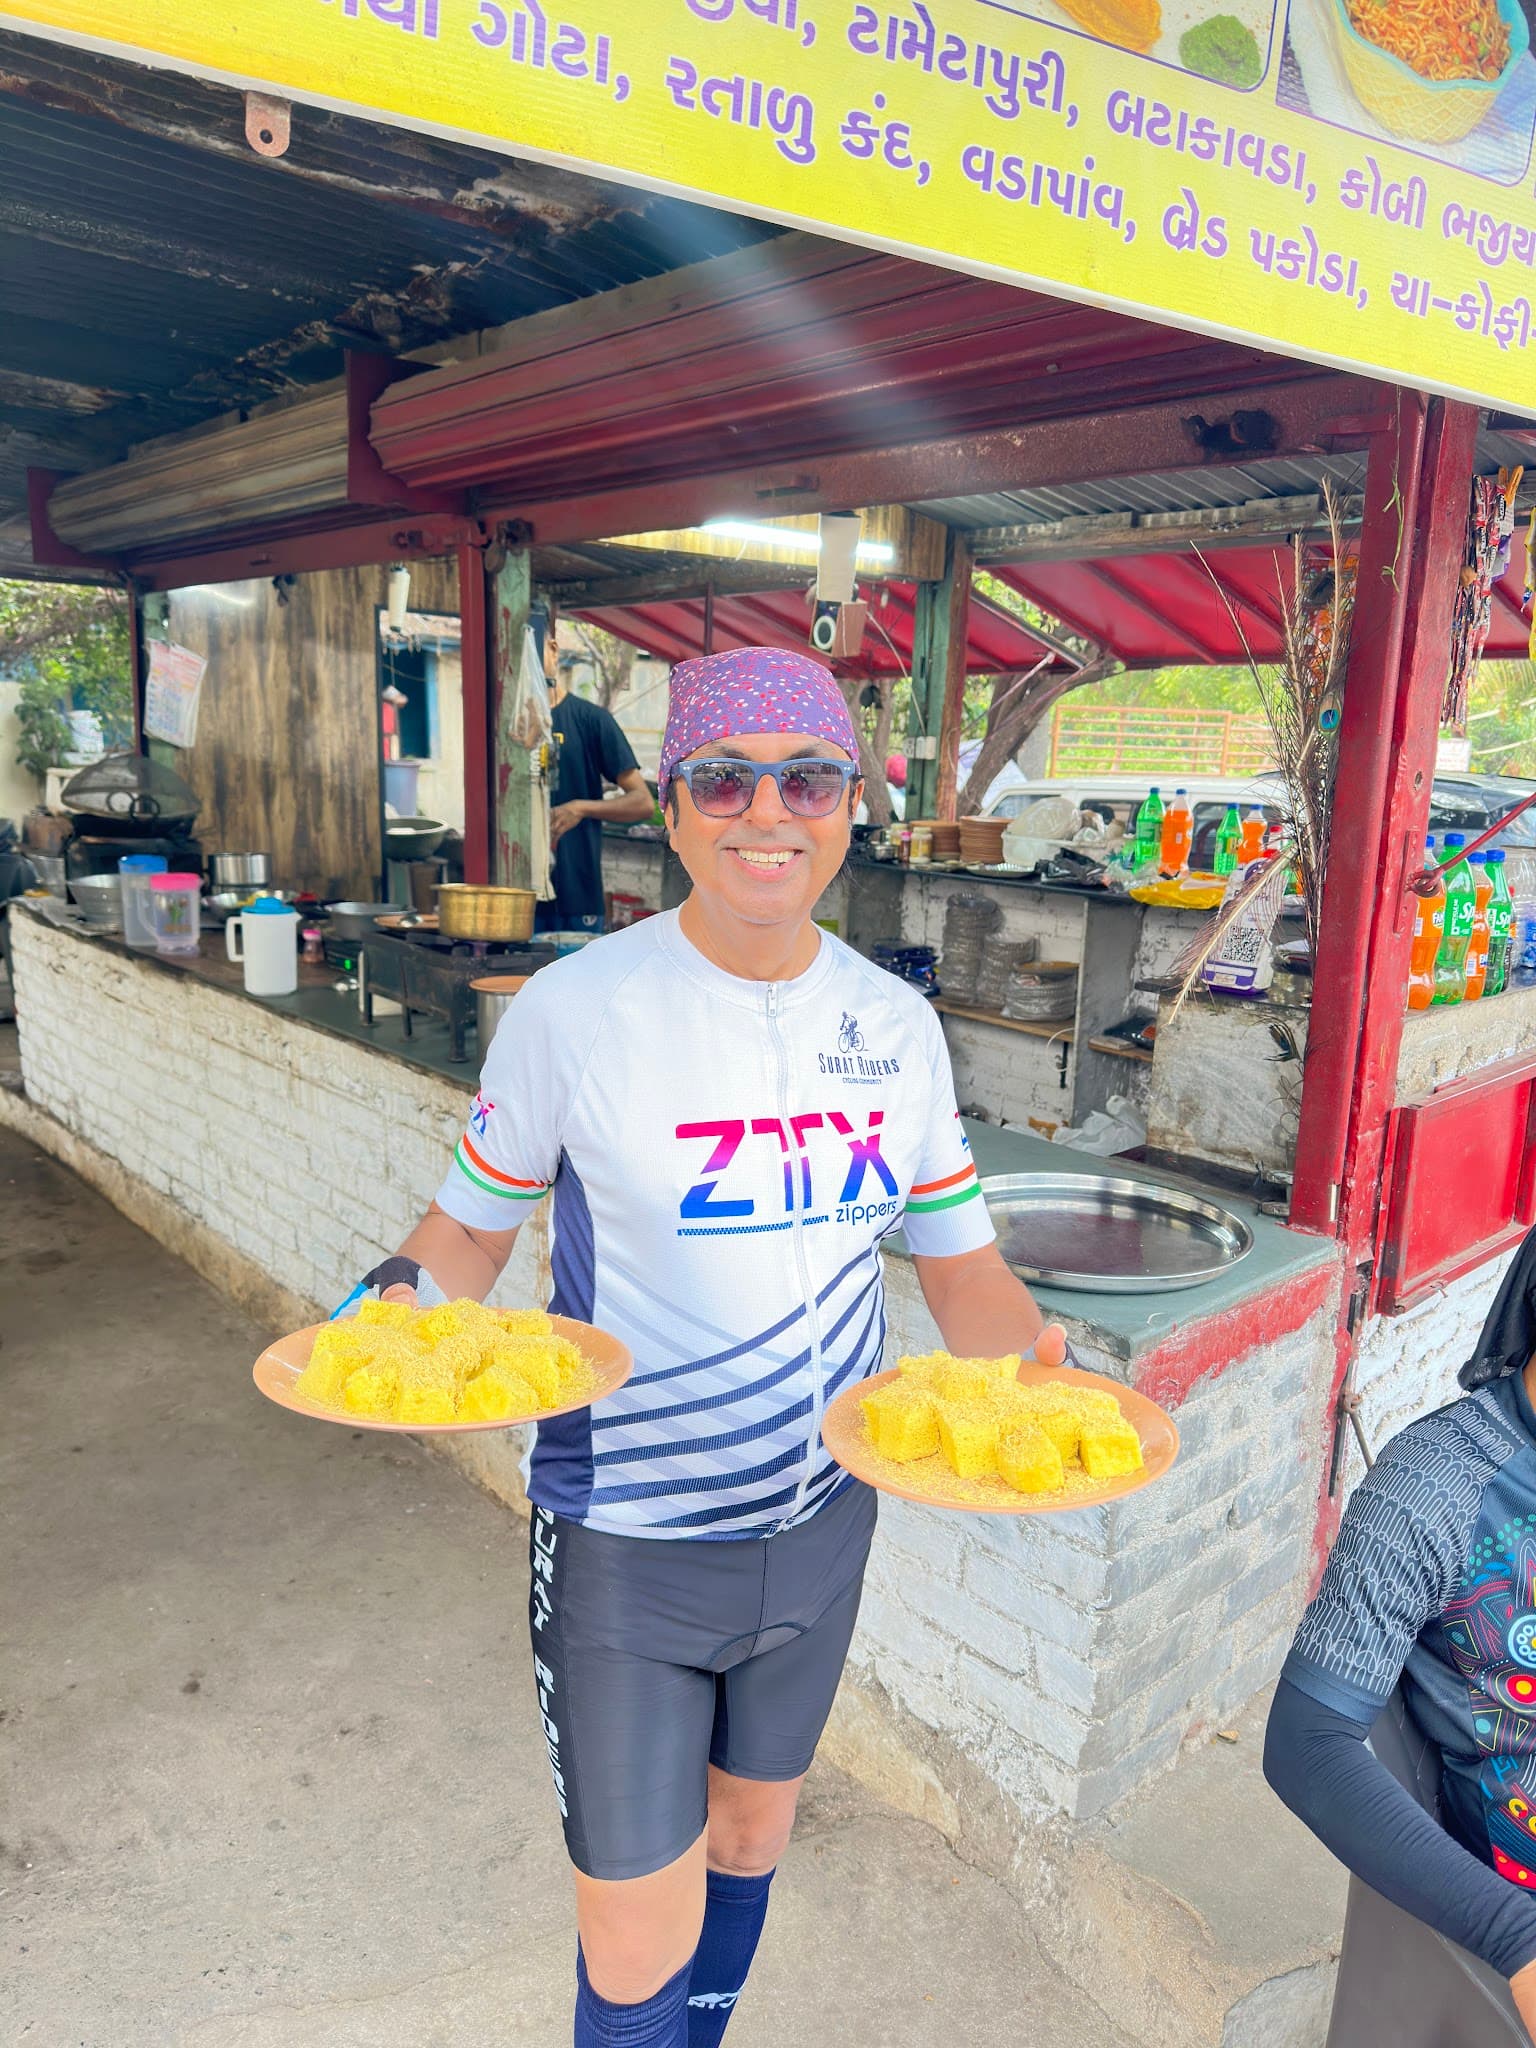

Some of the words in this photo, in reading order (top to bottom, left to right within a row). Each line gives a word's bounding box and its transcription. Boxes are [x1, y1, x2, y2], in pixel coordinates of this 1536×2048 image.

[665, 56, 816, 164] રતાળુ
[841, 94, 931, 186] કંદ,
[962, 146, 1136, 243] વડાપાંવ,
[1163, 187, 1228, 257] બ્રેડ
[1250, 226, 1368, 309] પકોડા,
[848, 2, 1078, 128] ટામેટાપુરી,
[1107, 90, 1316, 204] બટાકાવડા,
[1340, 156, 1427, 229] કોબી
[1442, 203, 1536, 266] ભજીય
[818, 1053, 855, 1075] SURAT
[857, 1056, 900, 1076] RIDERS
[676, 1111, 899, 1219] ZTX
[836, 1201, 898, 1225] zippers
